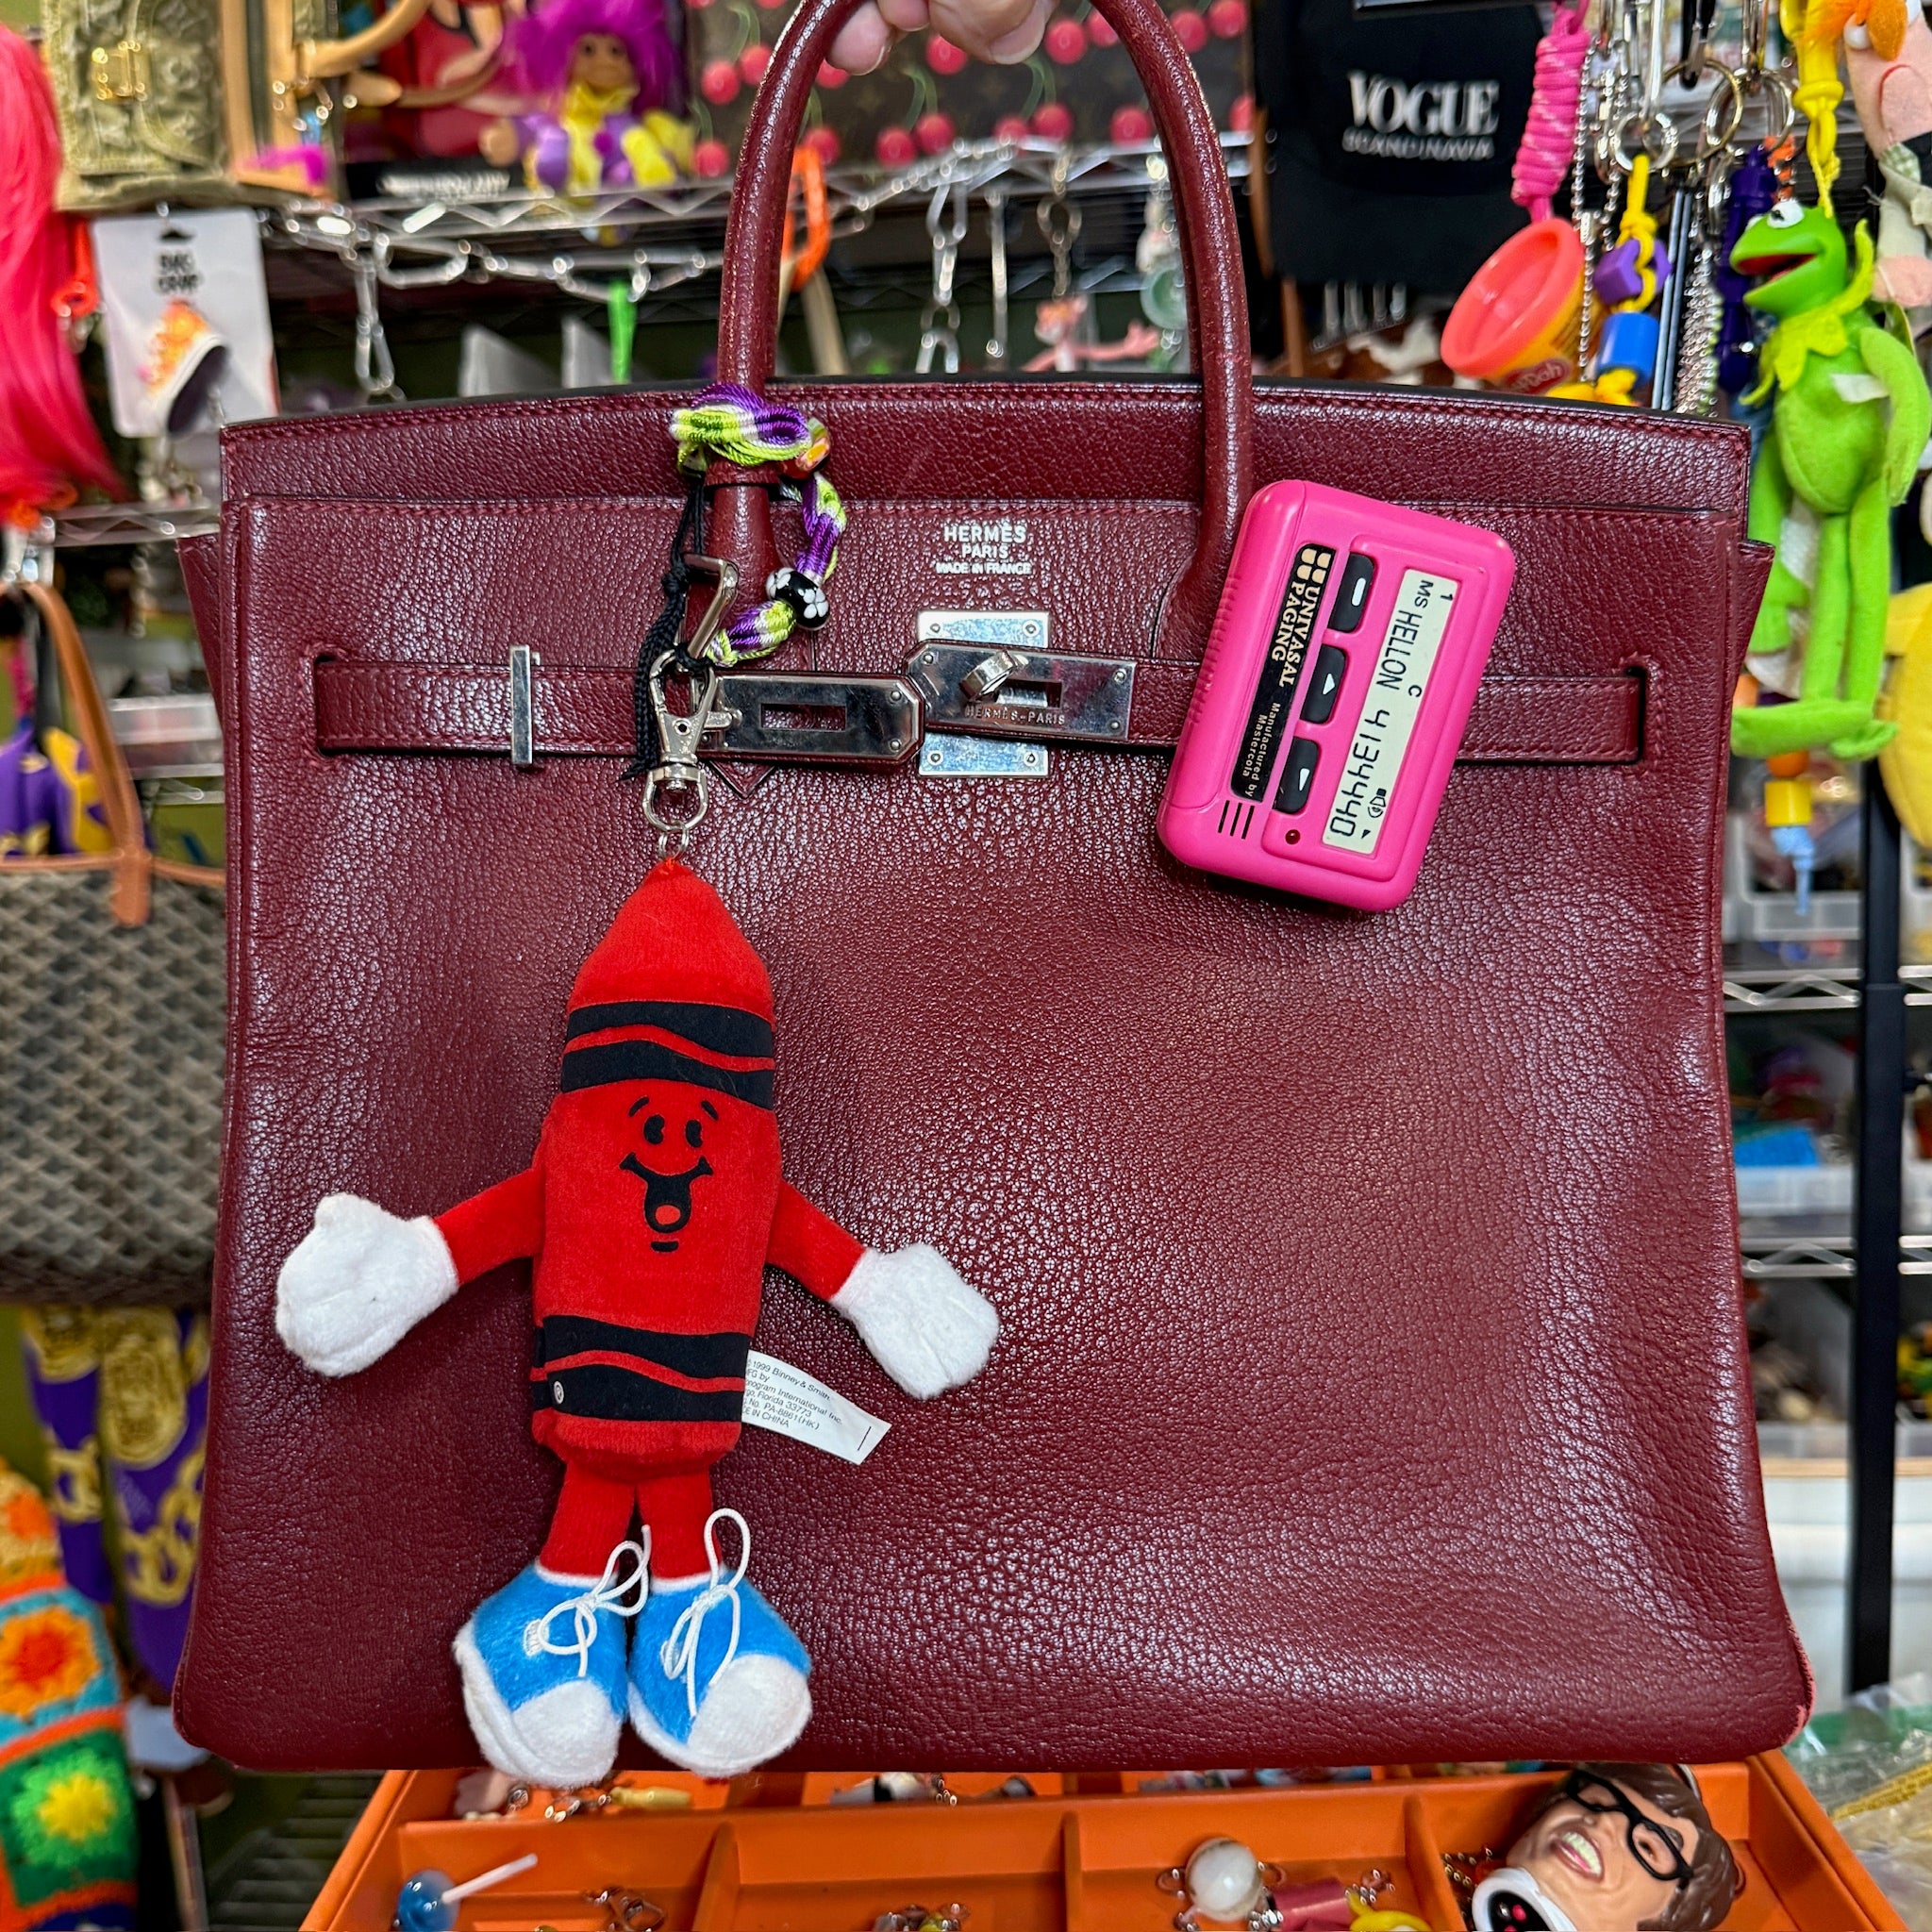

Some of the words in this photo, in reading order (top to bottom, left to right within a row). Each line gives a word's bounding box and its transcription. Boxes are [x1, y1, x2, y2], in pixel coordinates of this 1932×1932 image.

[1347, 70, 1500, 137] VOGUE
[944, 522, 1026, 543] HERMÈS
[962, 545, 1008, 558] PARIS
[936, 561, 969, 574] MADE
[971, 562, 983, 574] IN
[986, 562, 1031, 575] FRANCE
[1414, 580, 1434, 608] MS
[1272, 581, 1306, 661] PAGING
[1279, 586, 1321, 687] UNIVASAL
[1408, 685, 1423, 697] C
[1242, 714, 1268, 776] Mastercola
[1251, 702, 1281, 781] Manufactured
[1245, 783, 1257, 797] by
[753, 1360, 771, 1373] 1999
[772, 1367, 800, 1385] Binney
[759, 1373, 770, 1383] by
[758, 1391, 784, 1406] Florida
[785, 1401, 811, 1418] 33773
[777, 1389, 827, 1415] International
[752, 1408, 761, 1417] IN
[761, 1412, 789, 1428] CHINA
